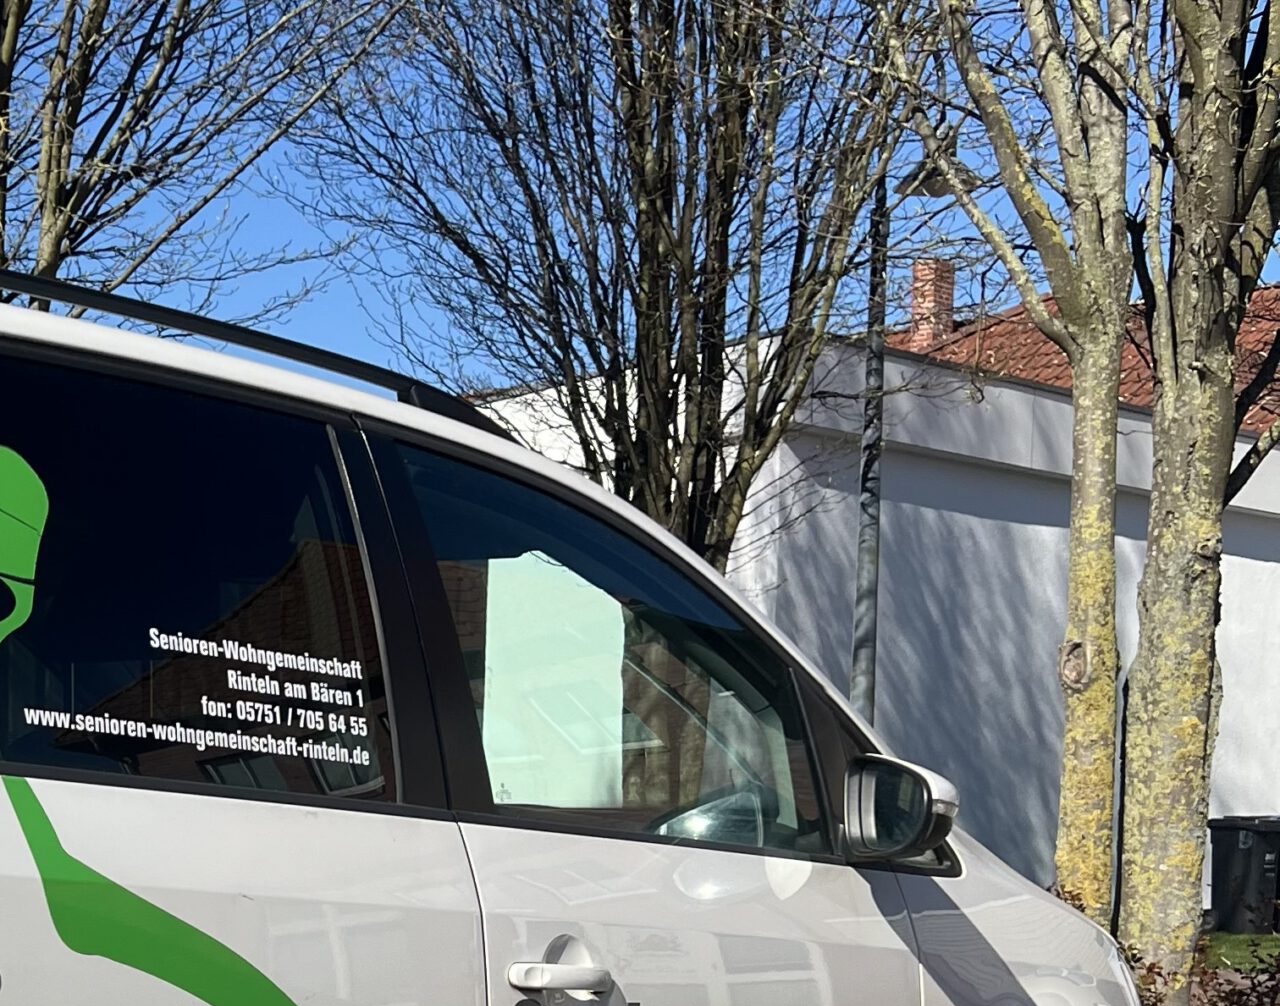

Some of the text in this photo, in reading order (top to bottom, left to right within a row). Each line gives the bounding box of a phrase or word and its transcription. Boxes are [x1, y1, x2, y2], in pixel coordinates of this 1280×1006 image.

[149, 627, 363, 680] Senioren-Wohngemeinschaft
[227, 669, 364, 708] Rinteln am Bären 1
[23, 707, 370, 766] www.senioren-wohngemeinschaft-rinteln.de
[200, 695, 368, 737] fon: 05751 / 705 64 55
